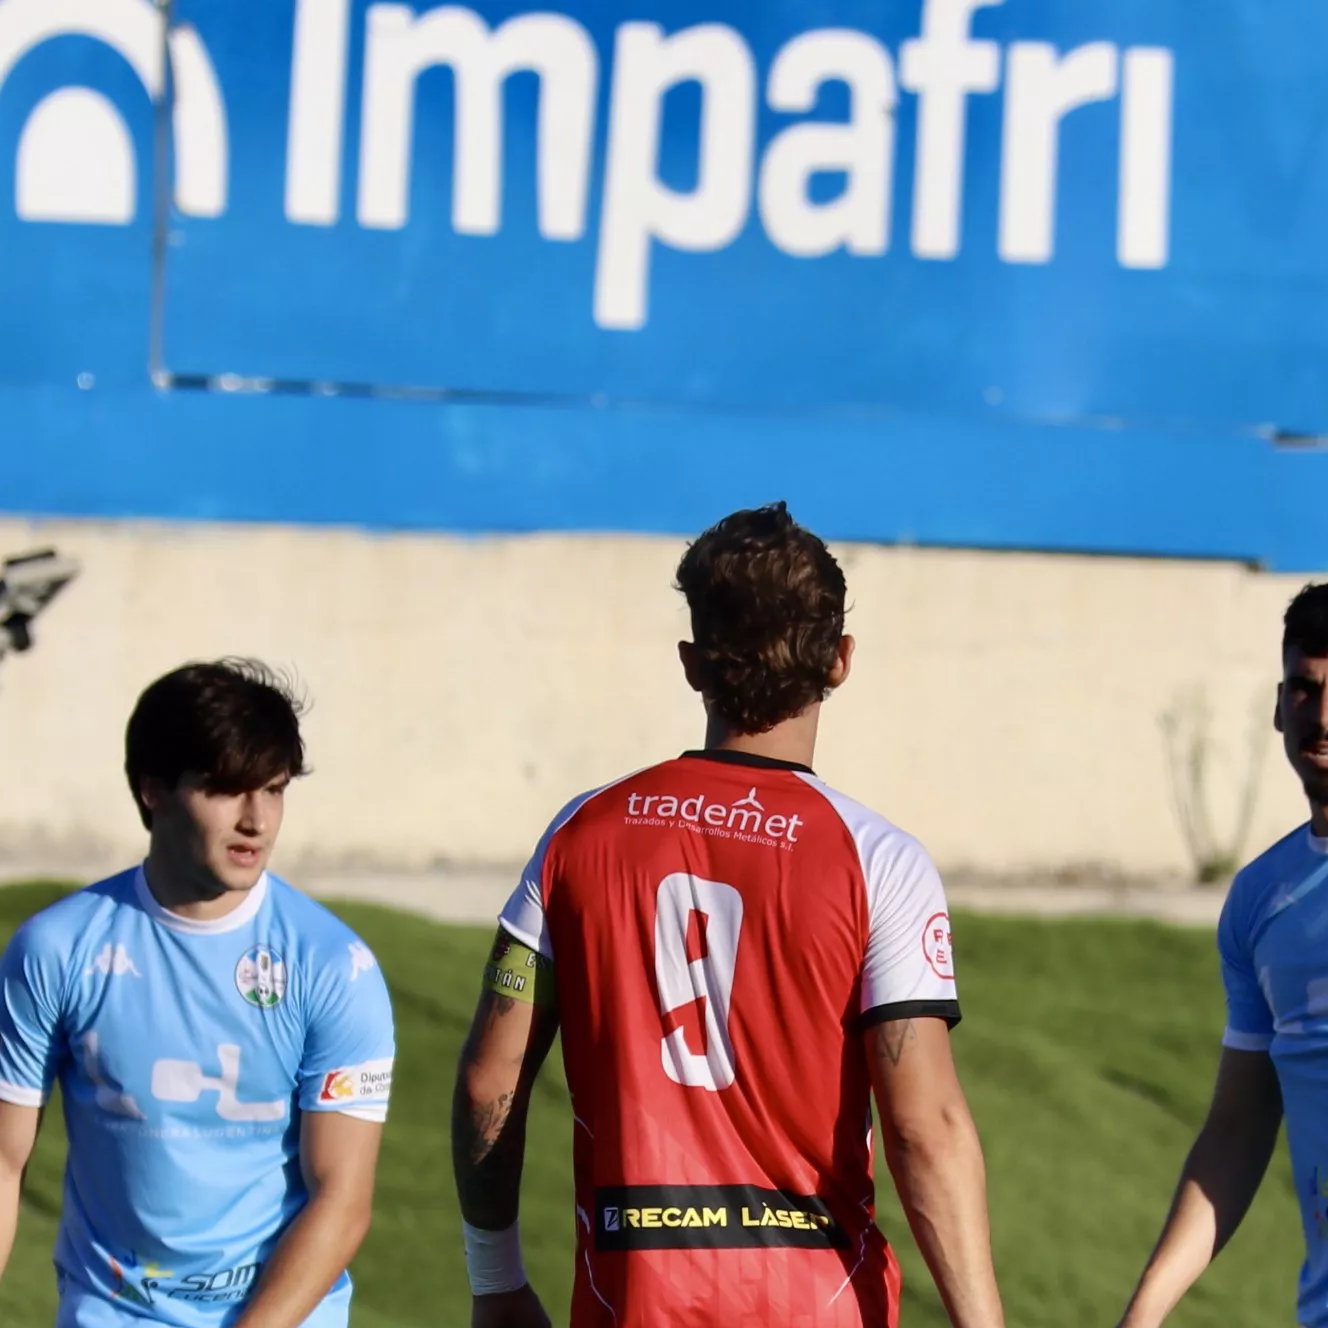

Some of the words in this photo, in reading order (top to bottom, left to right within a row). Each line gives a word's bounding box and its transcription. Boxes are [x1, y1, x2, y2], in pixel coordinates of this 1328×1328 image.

[285, 0, 1172, 329] Impafri
[624, 816, 666, 827] Trazados
[678, 819, 731, 839] Desarrollos
[733, 831, 778, 848] Metálicos
[780, 842, 794, 851] s.l.
[626, 792, 804, 843] trademet
[654, 872, 744, 1092] 9
[623, 1206, 728, 1229] RECAM
